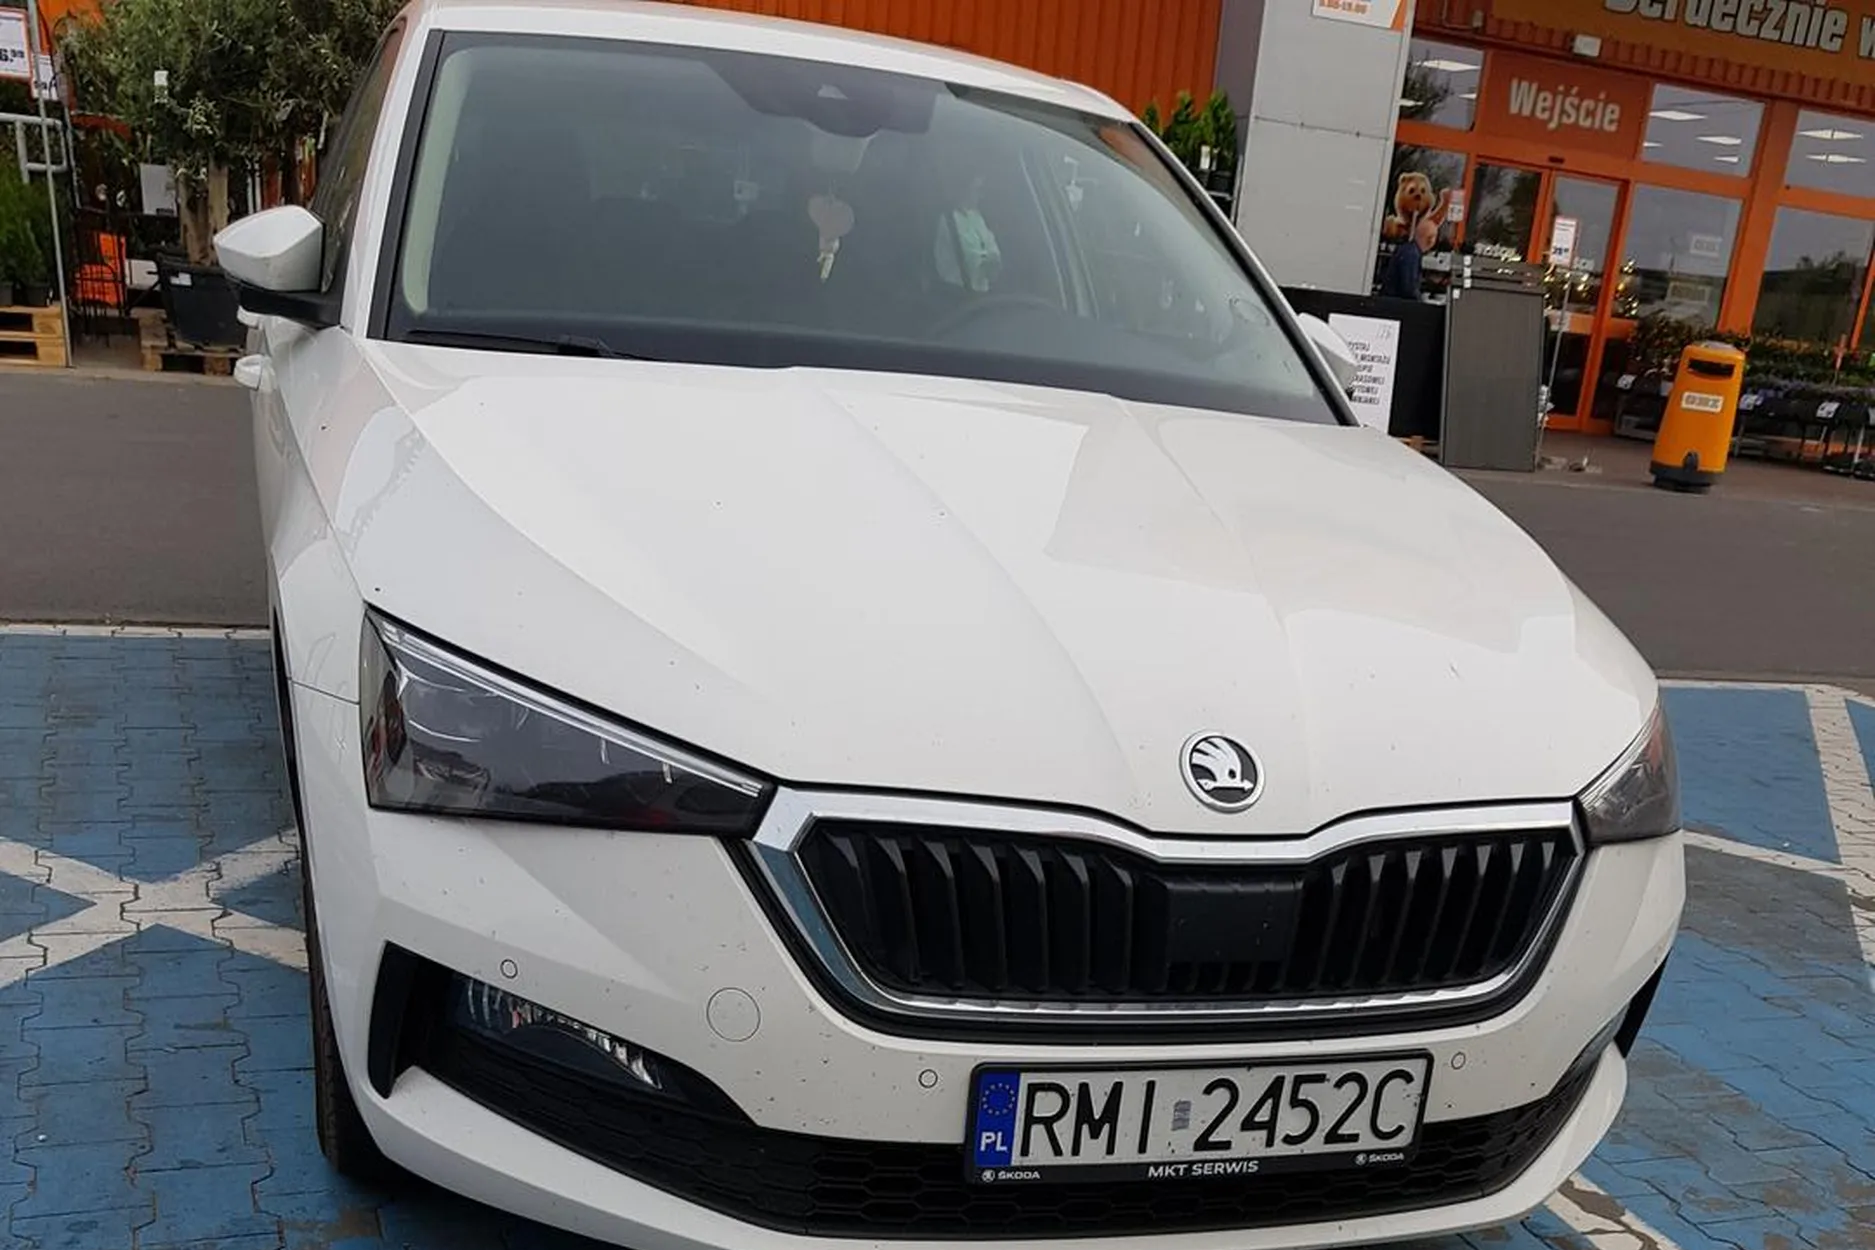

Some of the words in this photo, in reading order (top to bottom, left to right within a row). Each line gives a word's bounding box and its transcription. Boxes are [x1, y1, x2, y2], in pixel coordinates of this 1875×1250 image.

[1509, 77, 1621, 133] Wejście
[1018, 1080, 1156, 1158] RMI
[1193, 1068, 1415, 1152] 2452C
[979, 1130, 1008, 1152] PL
[1368, 1152, 1404, 1164] ŠKODA
[997, 1170, 1041, 1180] ŠKODA
[1148, 1165, 1188, 1178] MKT
[1191, 1161, 1259, 1176] SERWIS
